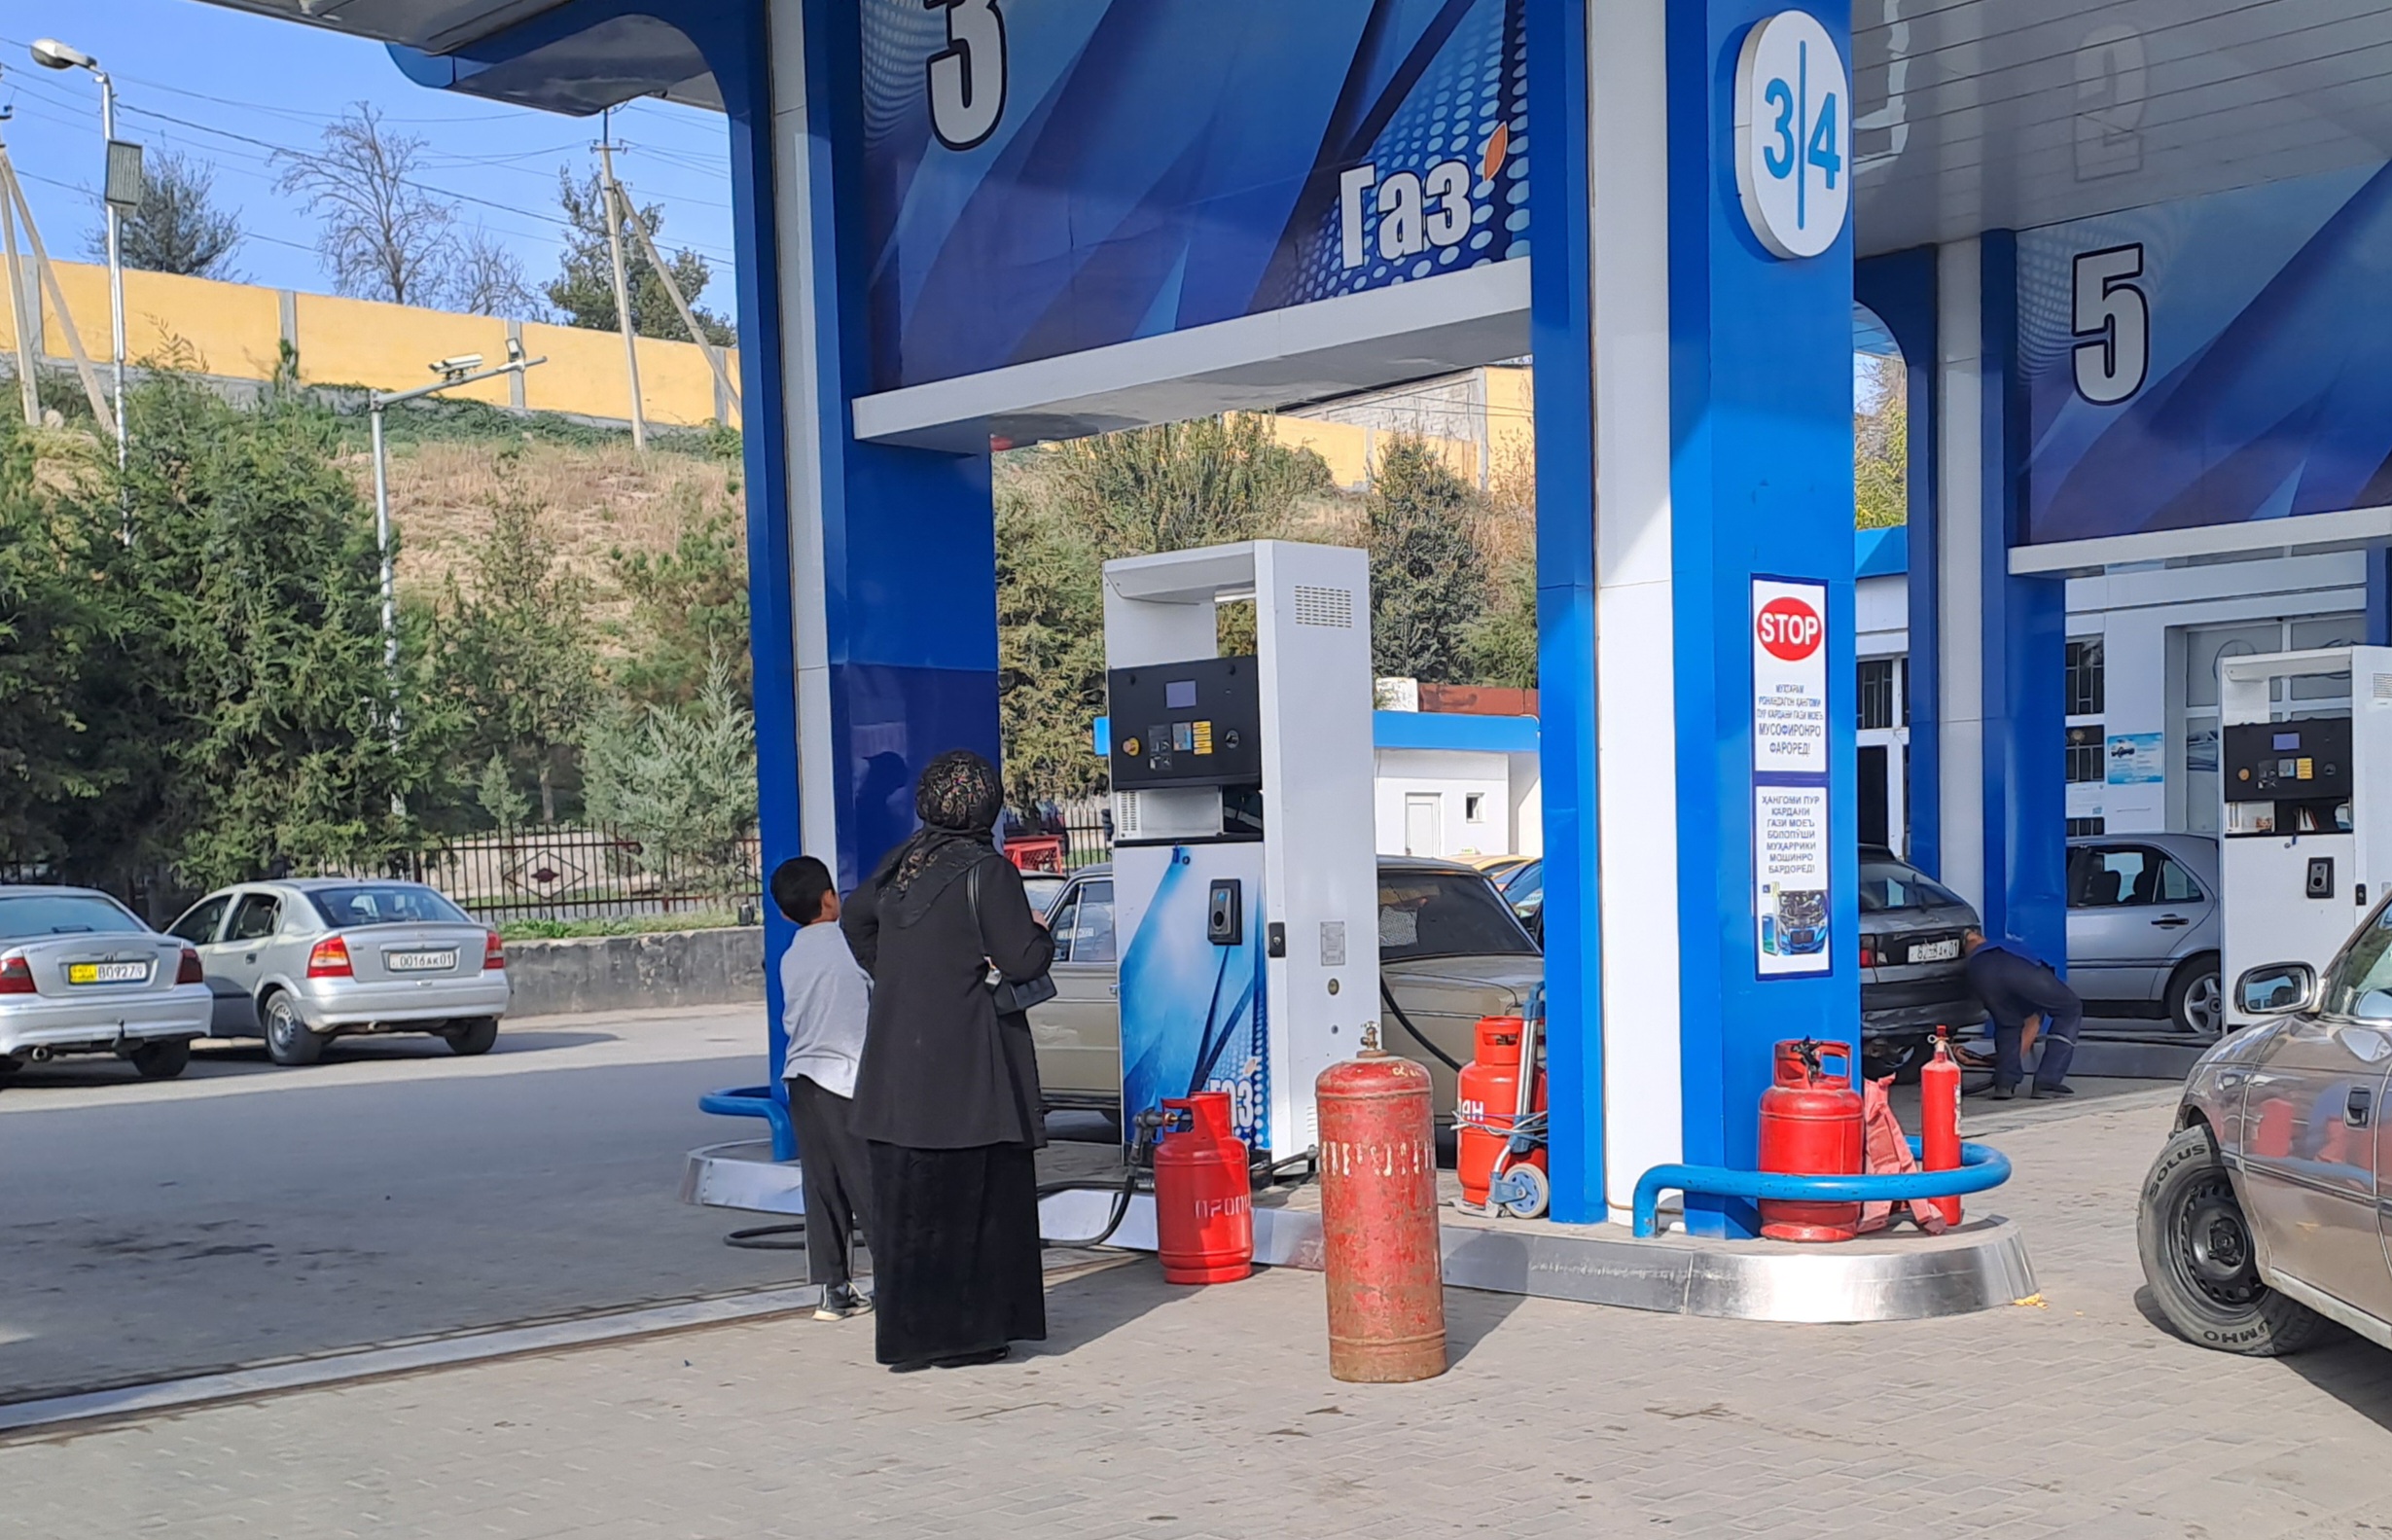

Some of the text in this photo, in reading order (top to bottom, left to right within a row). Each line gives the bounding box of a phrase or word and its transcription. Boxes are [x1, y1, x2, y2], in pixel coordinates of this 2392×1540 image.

[1339, 160, 1472, 269] Газ
[2071, 242, 2150, 406] 5
[1761, 612, 1819, 646] STOP
[1758, 723, 1821, 736] МУСОФИРОНРО
[1803, 796, 1820, 805] ПУР
[2148, 1143, 2206, 1199] SOLUS
